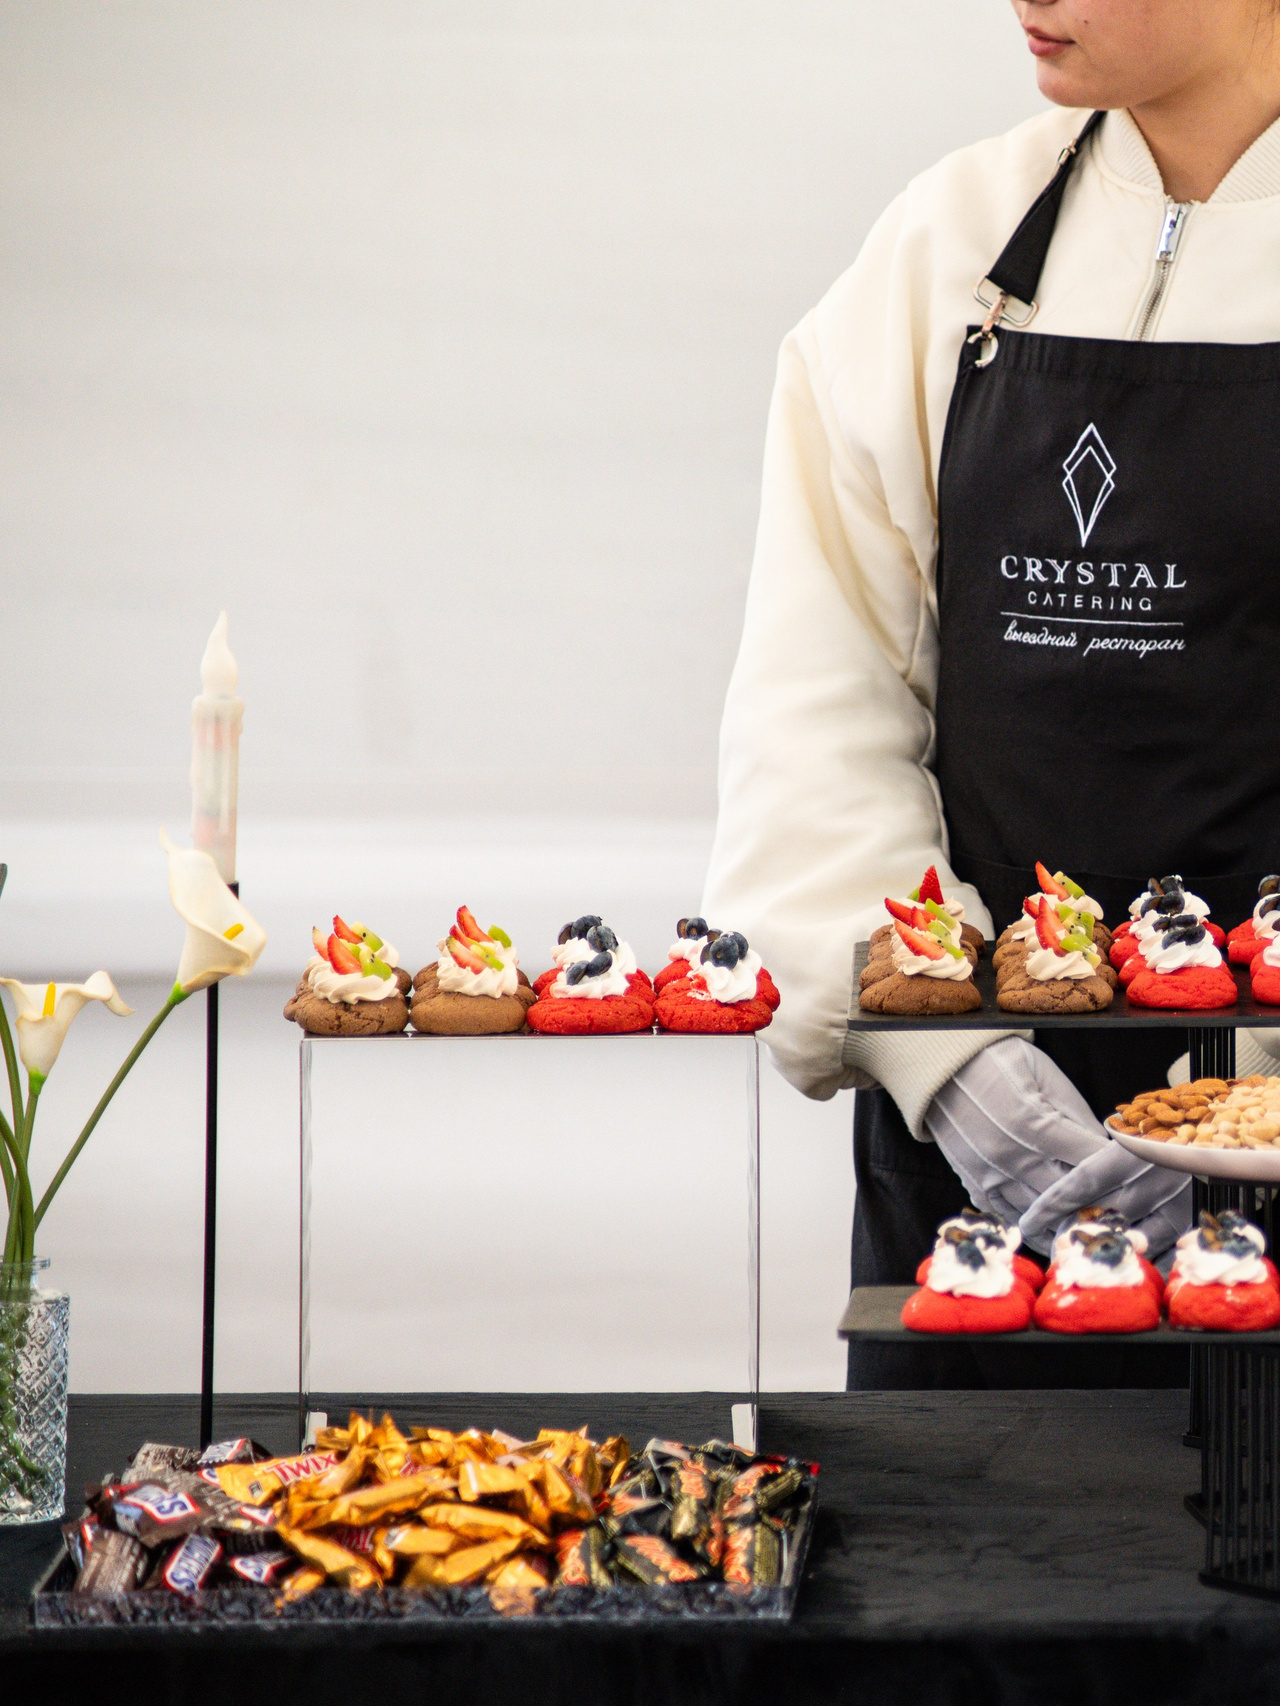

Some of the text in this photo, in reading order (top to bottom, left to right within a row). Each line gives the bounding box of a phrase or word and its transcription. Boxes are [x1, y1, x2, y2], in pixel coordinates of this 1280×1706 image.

[1001, 555, 1187, 588] CRYSTAL
[1028, 591, 1152, 611] CATERING
[1003, 619, 1186, 659] выездной ресторан
